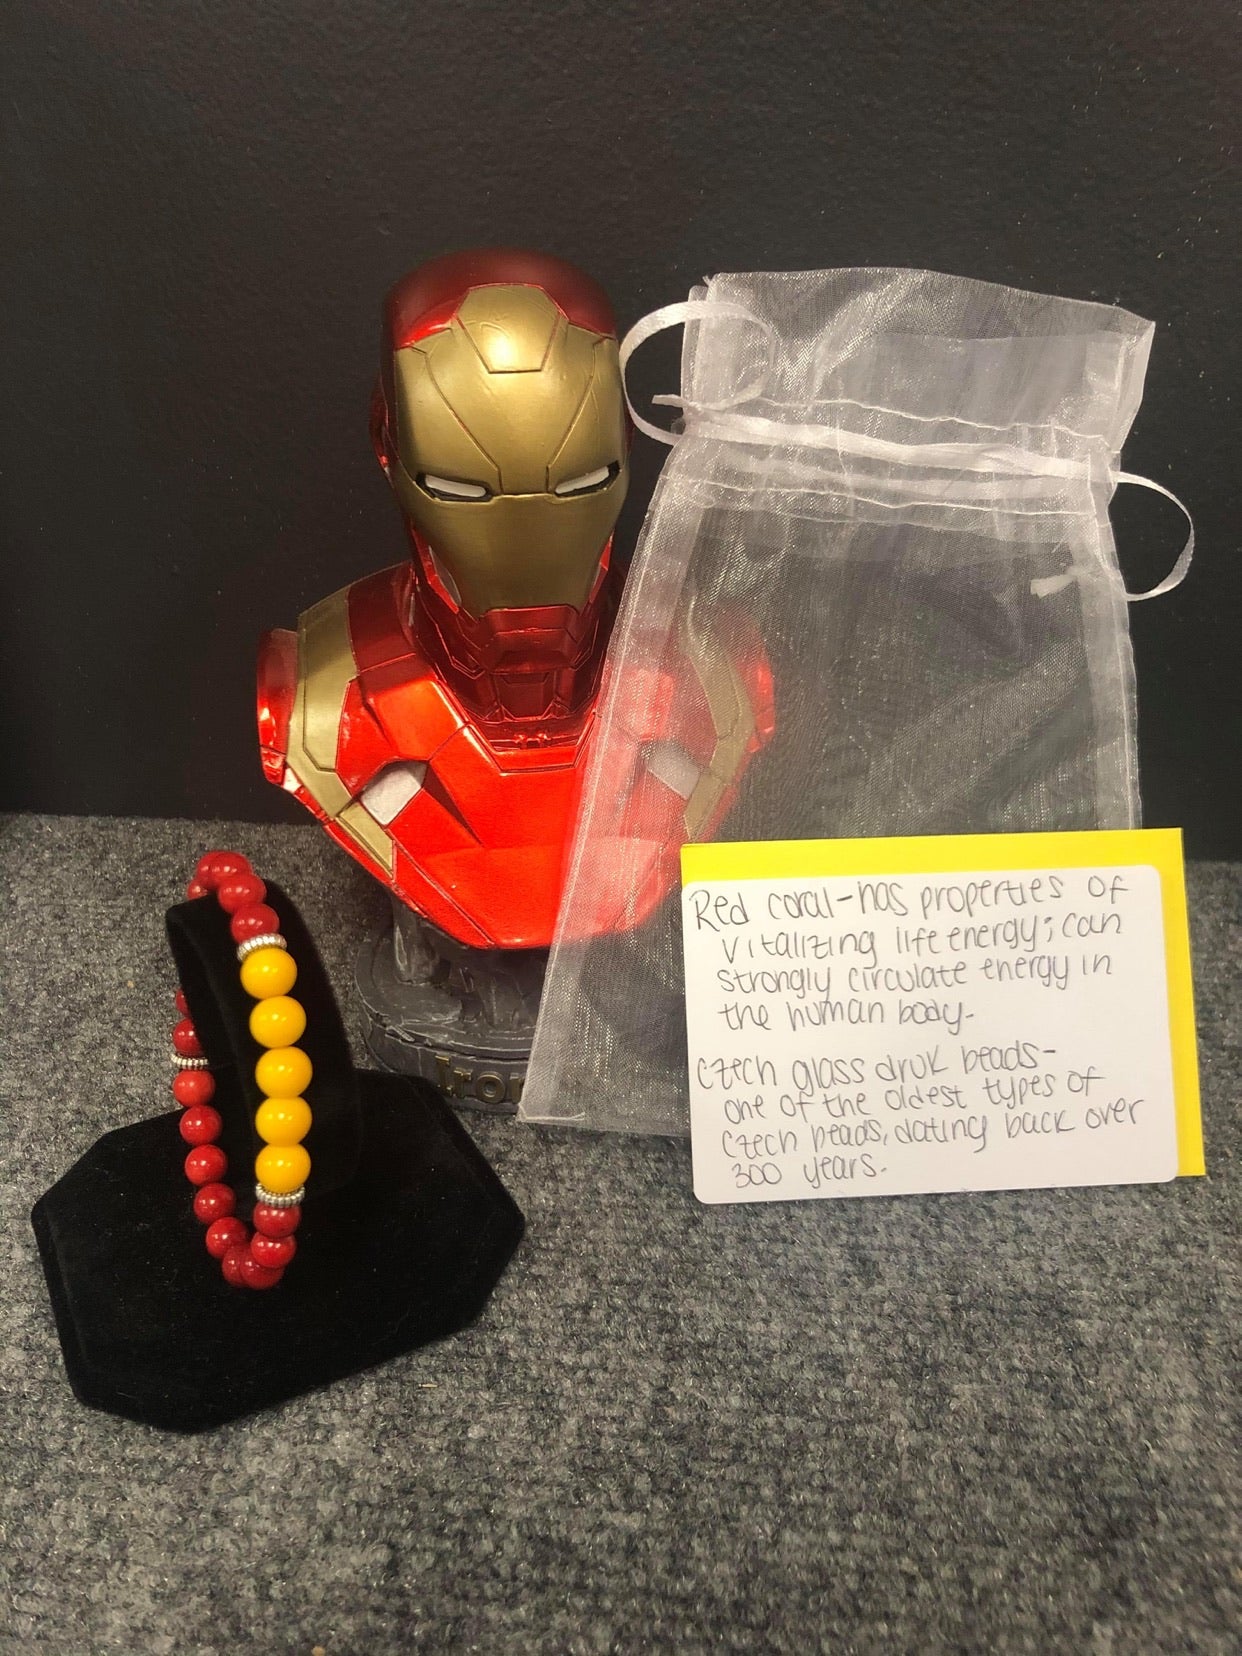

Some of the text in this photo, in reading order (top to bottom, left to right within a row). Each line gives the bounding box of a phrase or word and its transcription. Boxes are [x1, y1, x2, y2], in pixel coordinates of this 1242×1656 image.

[690, 889, 749, 931] Red
[920, 876, 1063, 919] properties
[896, 926, 941, 956] life
[1062, 912, 1121, 937] can
[717, 954, 1112, 1000] strongly circulate energy in
[717, 1002, 772, 1030] the
[786, 998, 884, 1031] human
[724, 1066, 1106, 1124] one of the oldest types of
[792, 1056, 865, 1097] glass
[875, 1045, 948, 1083] druk
[895, 1115, 987, 1153] dating
[1005, 1110, 1075, 1138] back
[1086, 1098, 1144, 1128] over
[732, 1162, 782, 1188] 300
